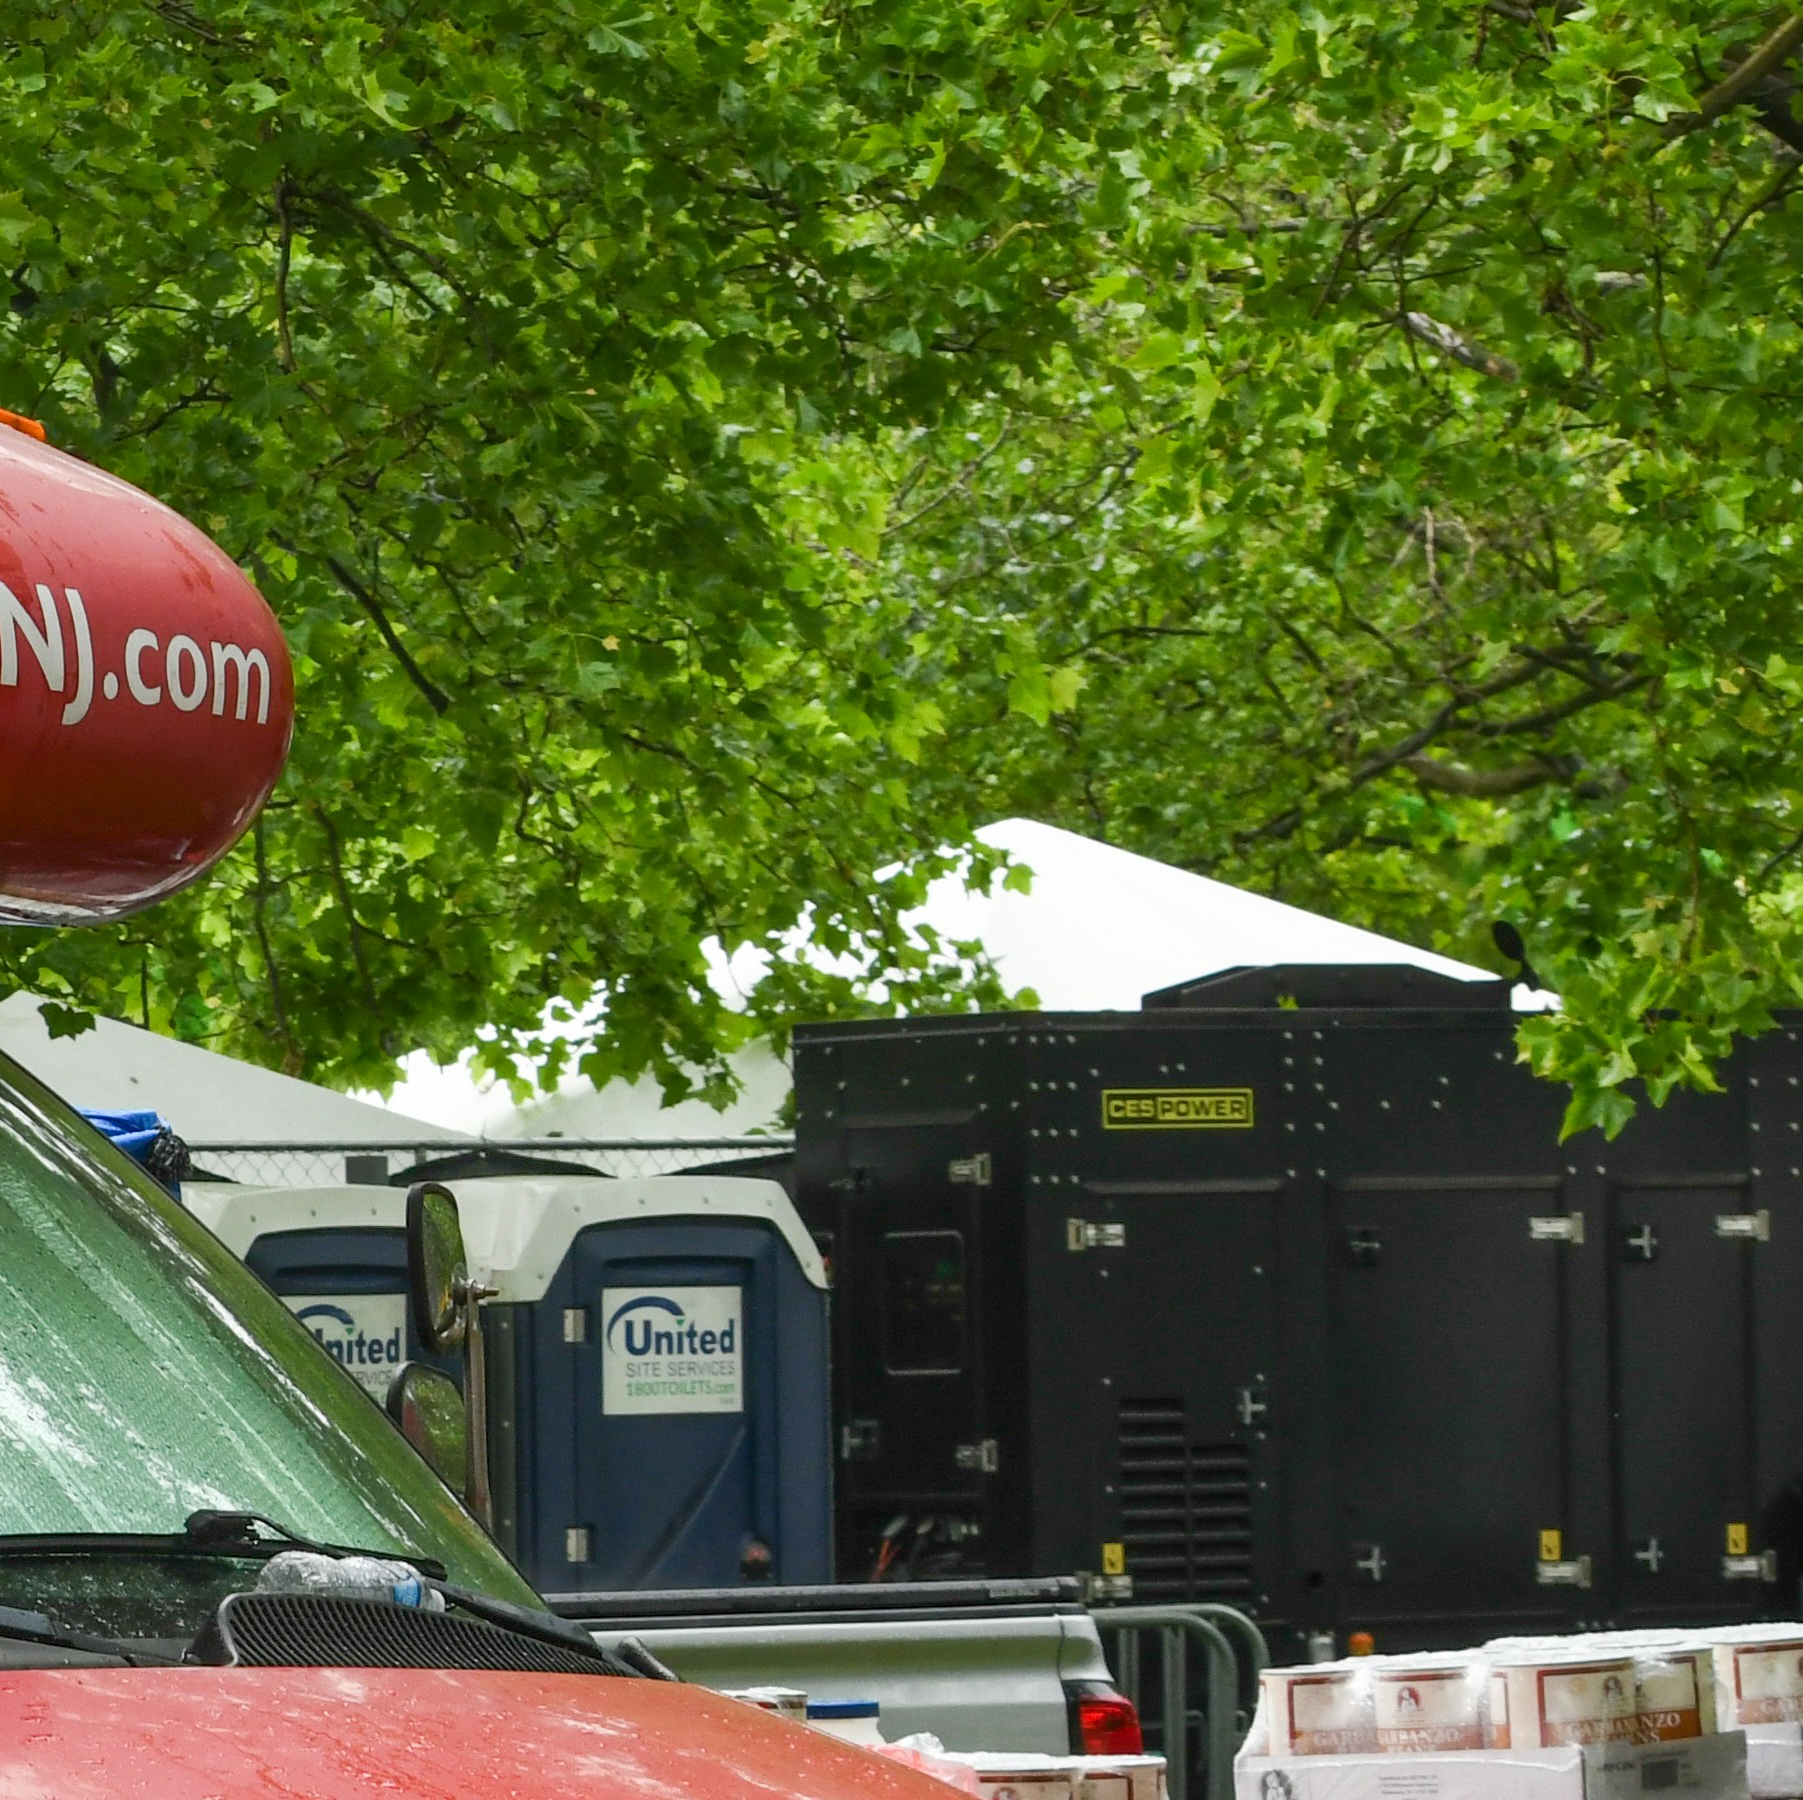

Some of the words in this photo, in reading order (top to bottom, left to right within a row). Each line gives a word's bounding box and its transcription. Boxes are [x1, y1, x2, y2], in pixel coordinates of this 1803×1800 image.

[624, 1317, 735, 1356] United
[626, 1361, 662, 1378] SITE
[667, 1360, 735, 1377] SERVICES
